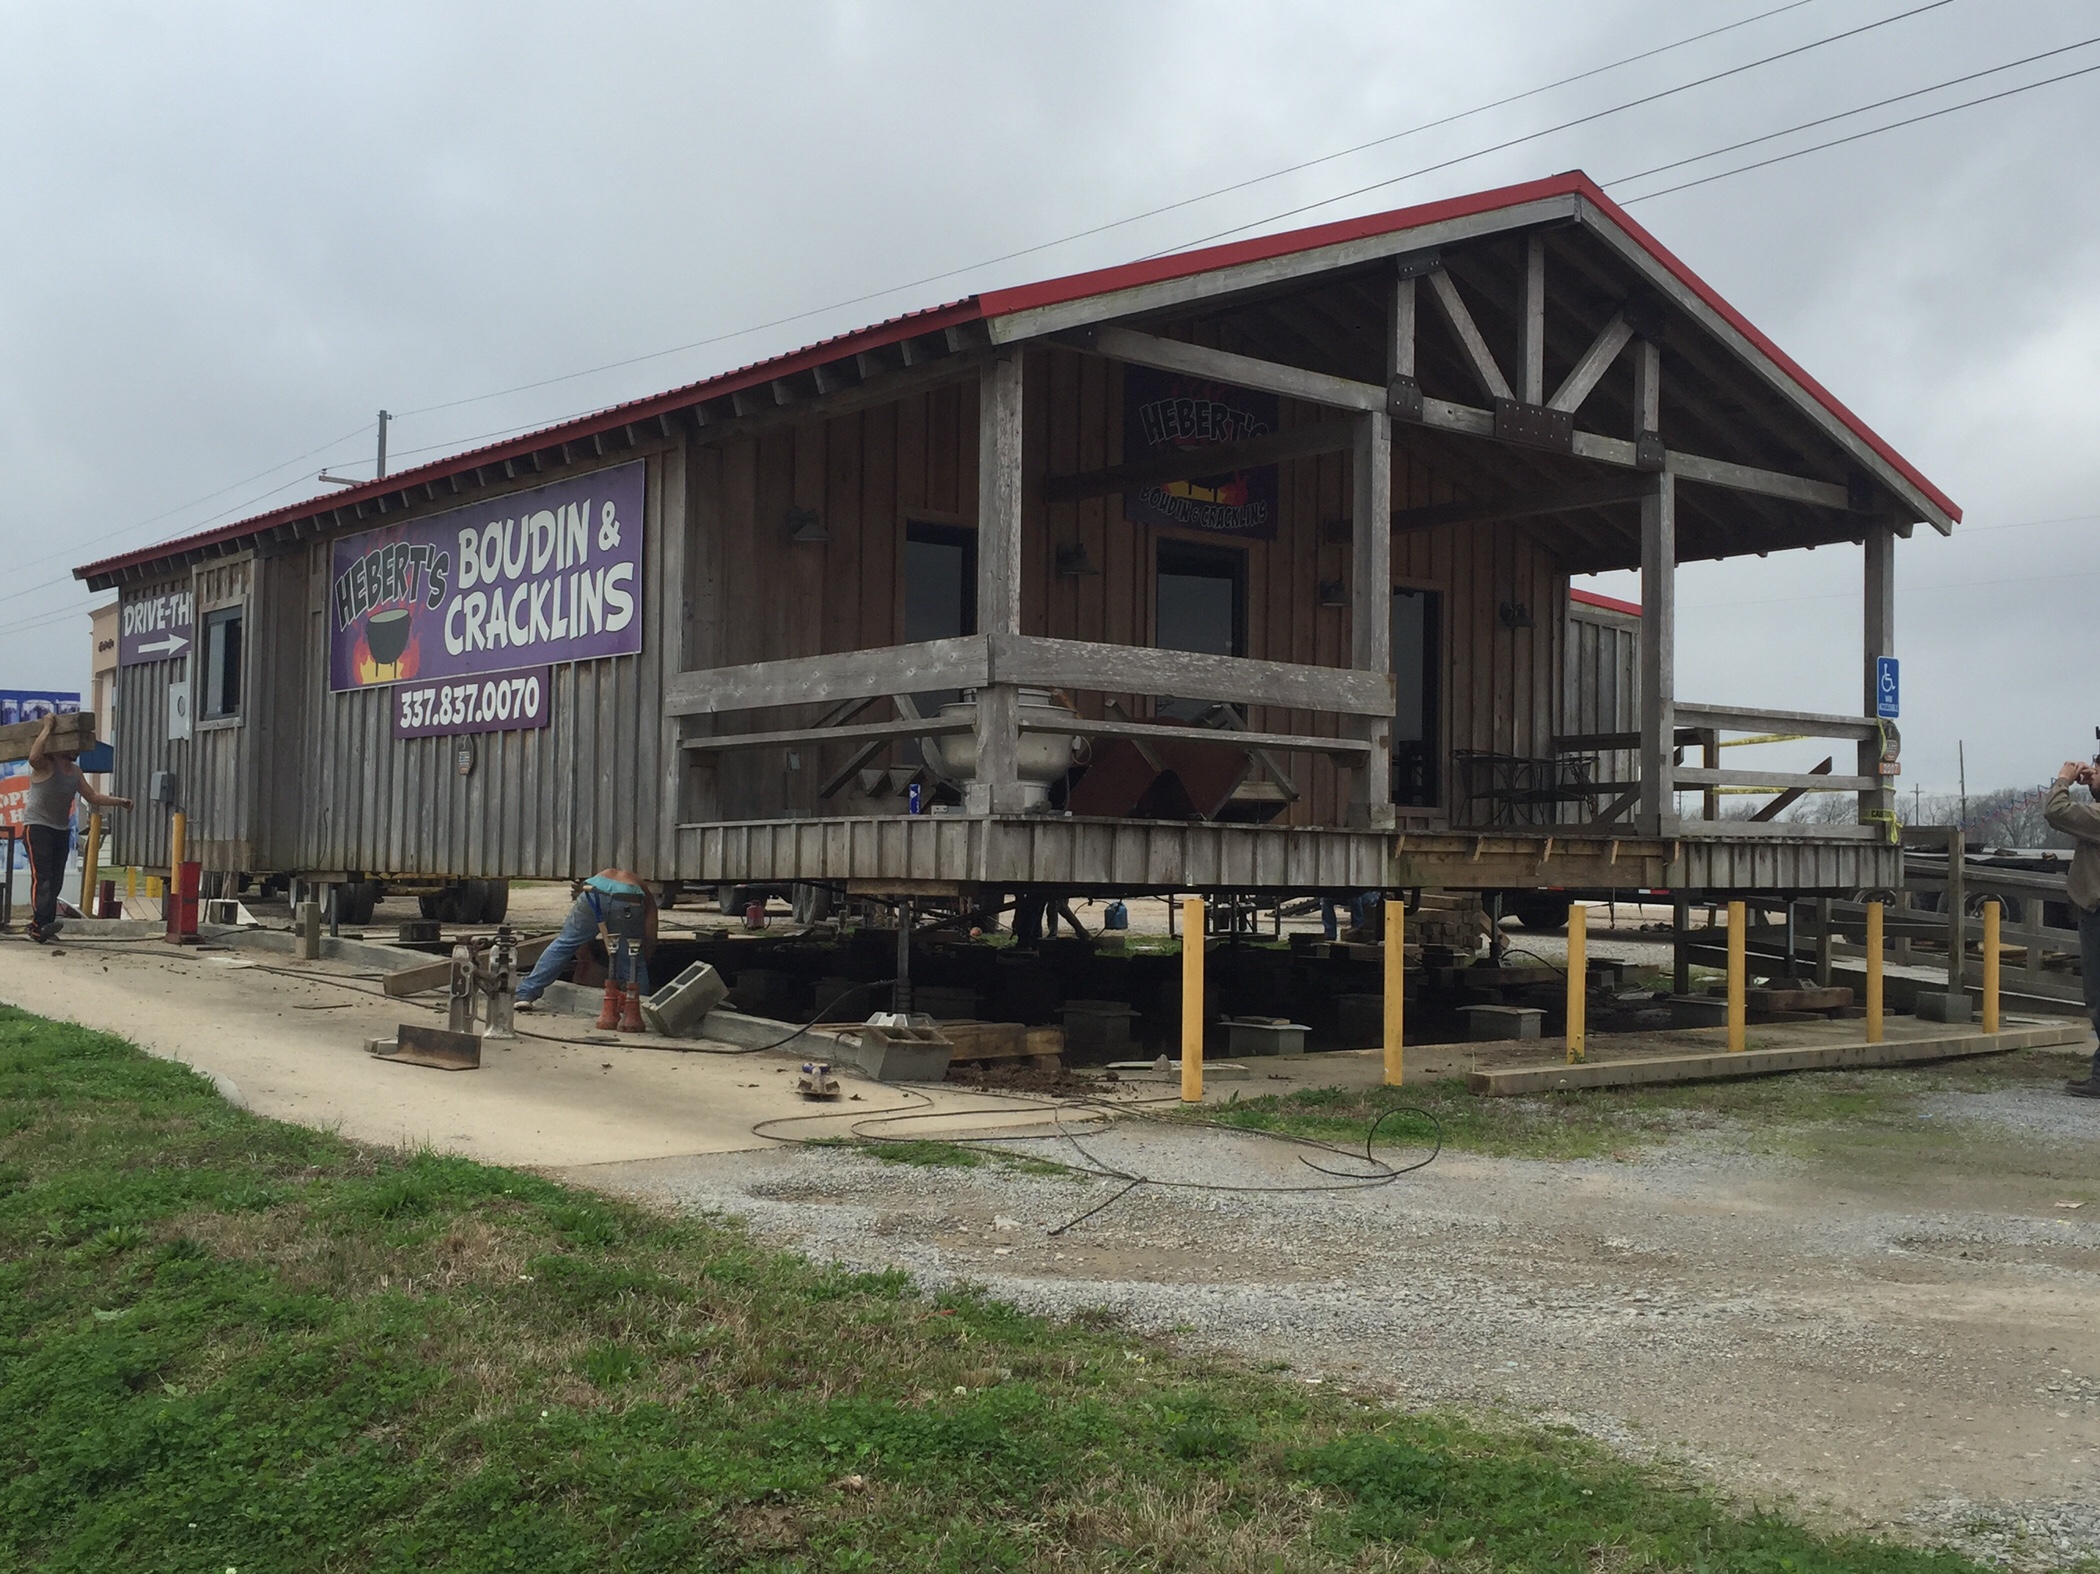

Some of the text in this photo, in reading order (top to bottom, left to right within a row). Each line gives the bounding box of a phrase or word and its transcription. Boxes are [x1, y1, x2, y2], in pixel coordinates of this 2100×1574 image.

[457, 498, 622, 590] BOUDIN &
[1139, 486, 1192, 522] BOUDIN
[1200, 500, 1267, 529] CRACKLINS
[334, 541, 450, 632] HEBERT'S
[443, 561, 635, 656] CRACKLINS
[400, 676, 540, 729] 337.837.0070
